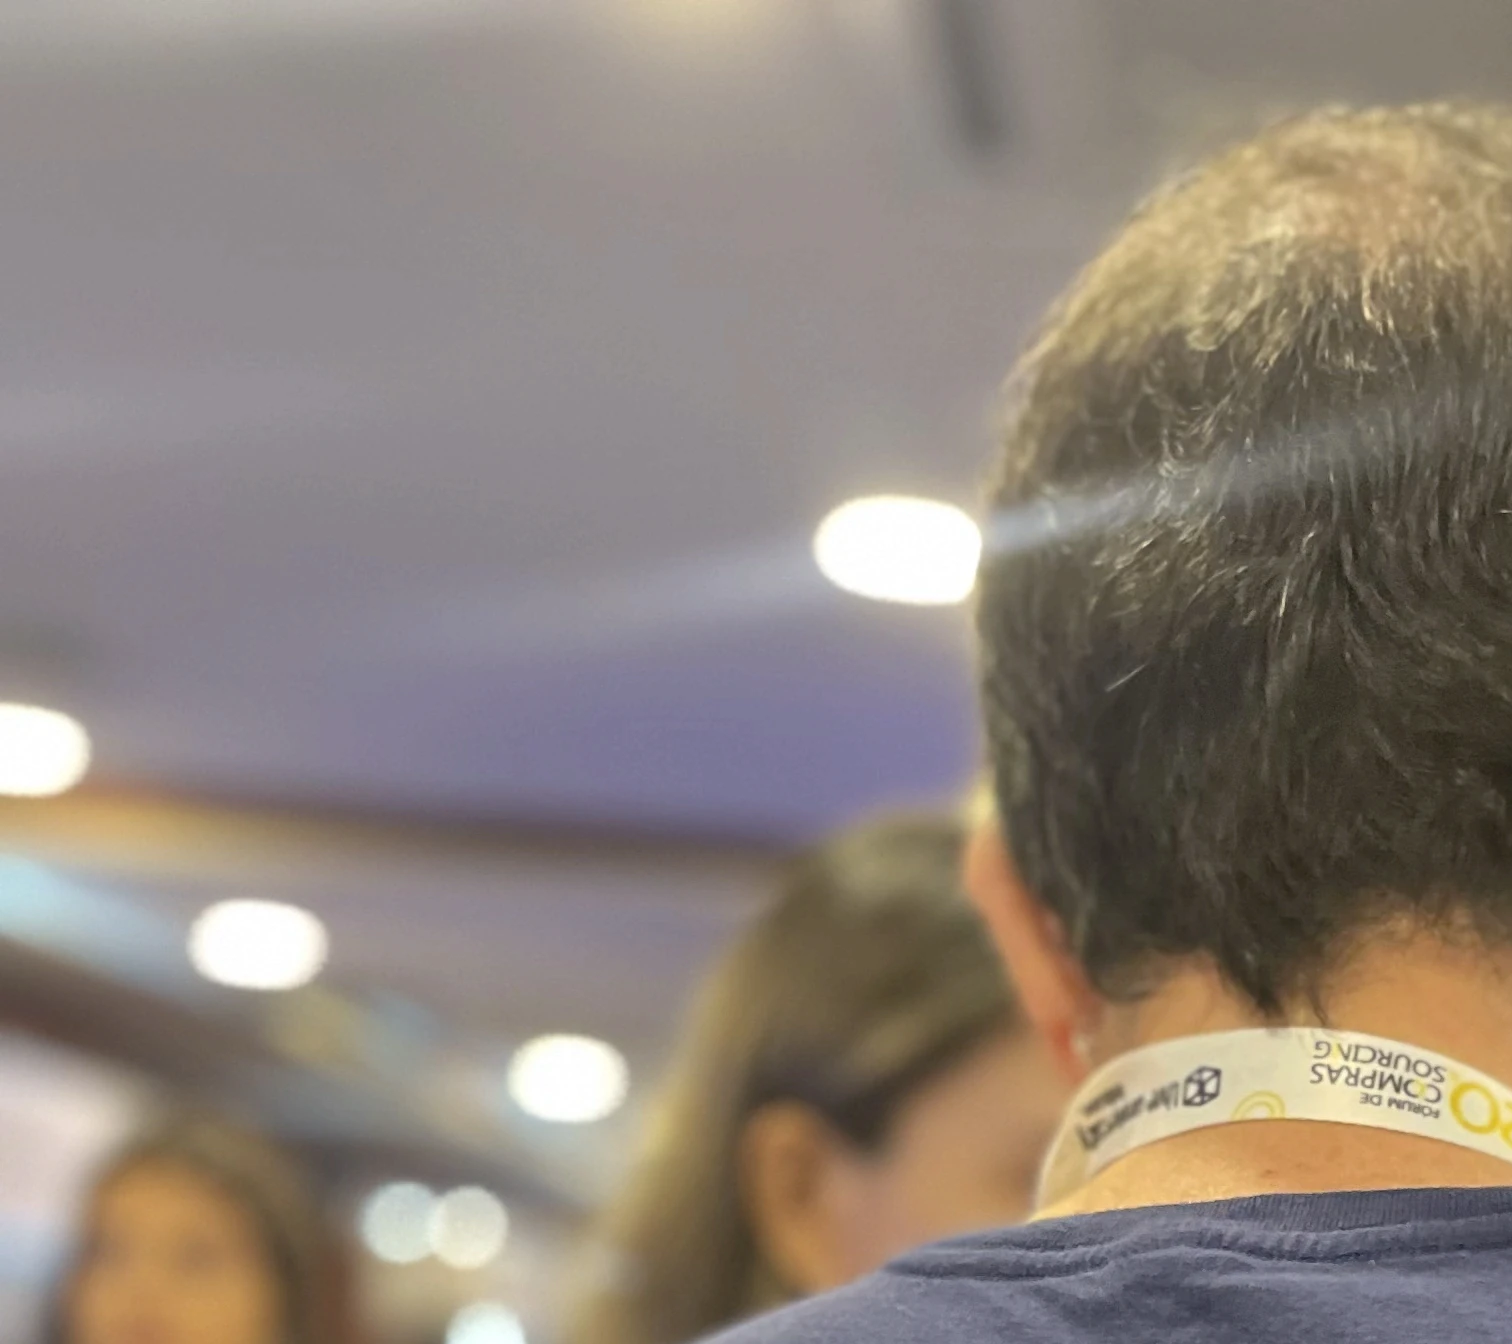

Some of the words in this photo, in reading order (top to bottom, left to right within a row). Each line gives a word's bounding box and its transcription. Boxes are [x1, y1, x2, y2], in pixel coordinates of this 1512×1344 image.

[1309, 1062, 1443, 1104] COMPRAS
[1312, 1040, 1448, 1084] SOURCING
[1358, 1091, 1382, 1107] DE
